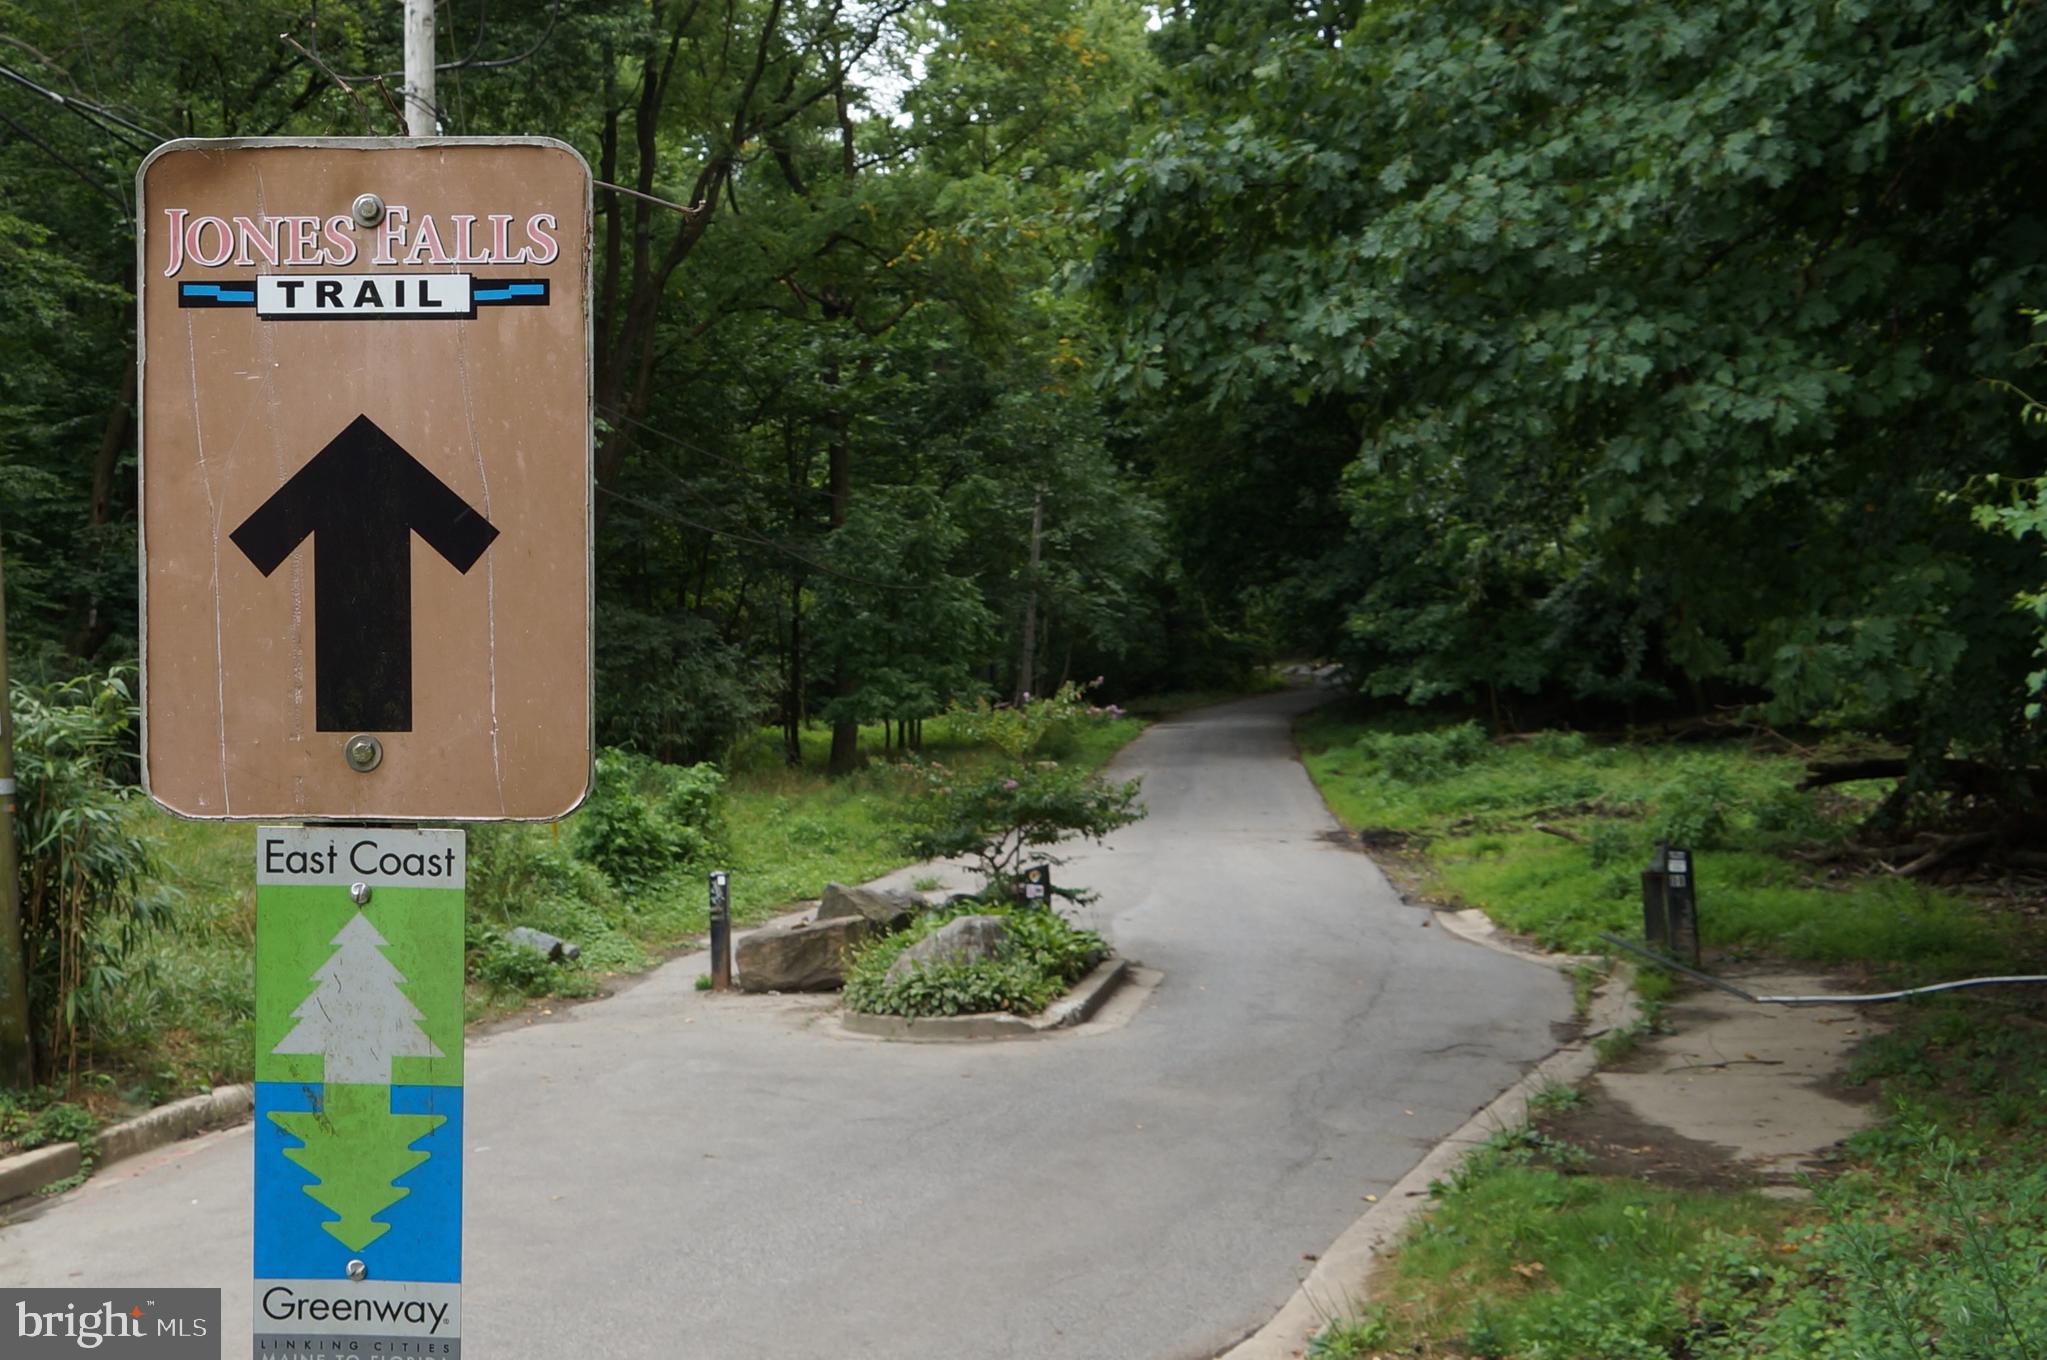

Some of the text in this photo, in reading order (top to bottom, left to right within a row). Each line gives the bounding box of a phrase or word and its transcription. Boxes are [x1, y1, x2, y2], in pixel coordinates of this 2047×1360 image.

[164, 205, 559, 277] JONES FALLS
[277, 280, 443, 308] TRAIL
[266, 839, 455, 877] East Coast
[261, 1339, 450, 1354] LINKING CITIES
